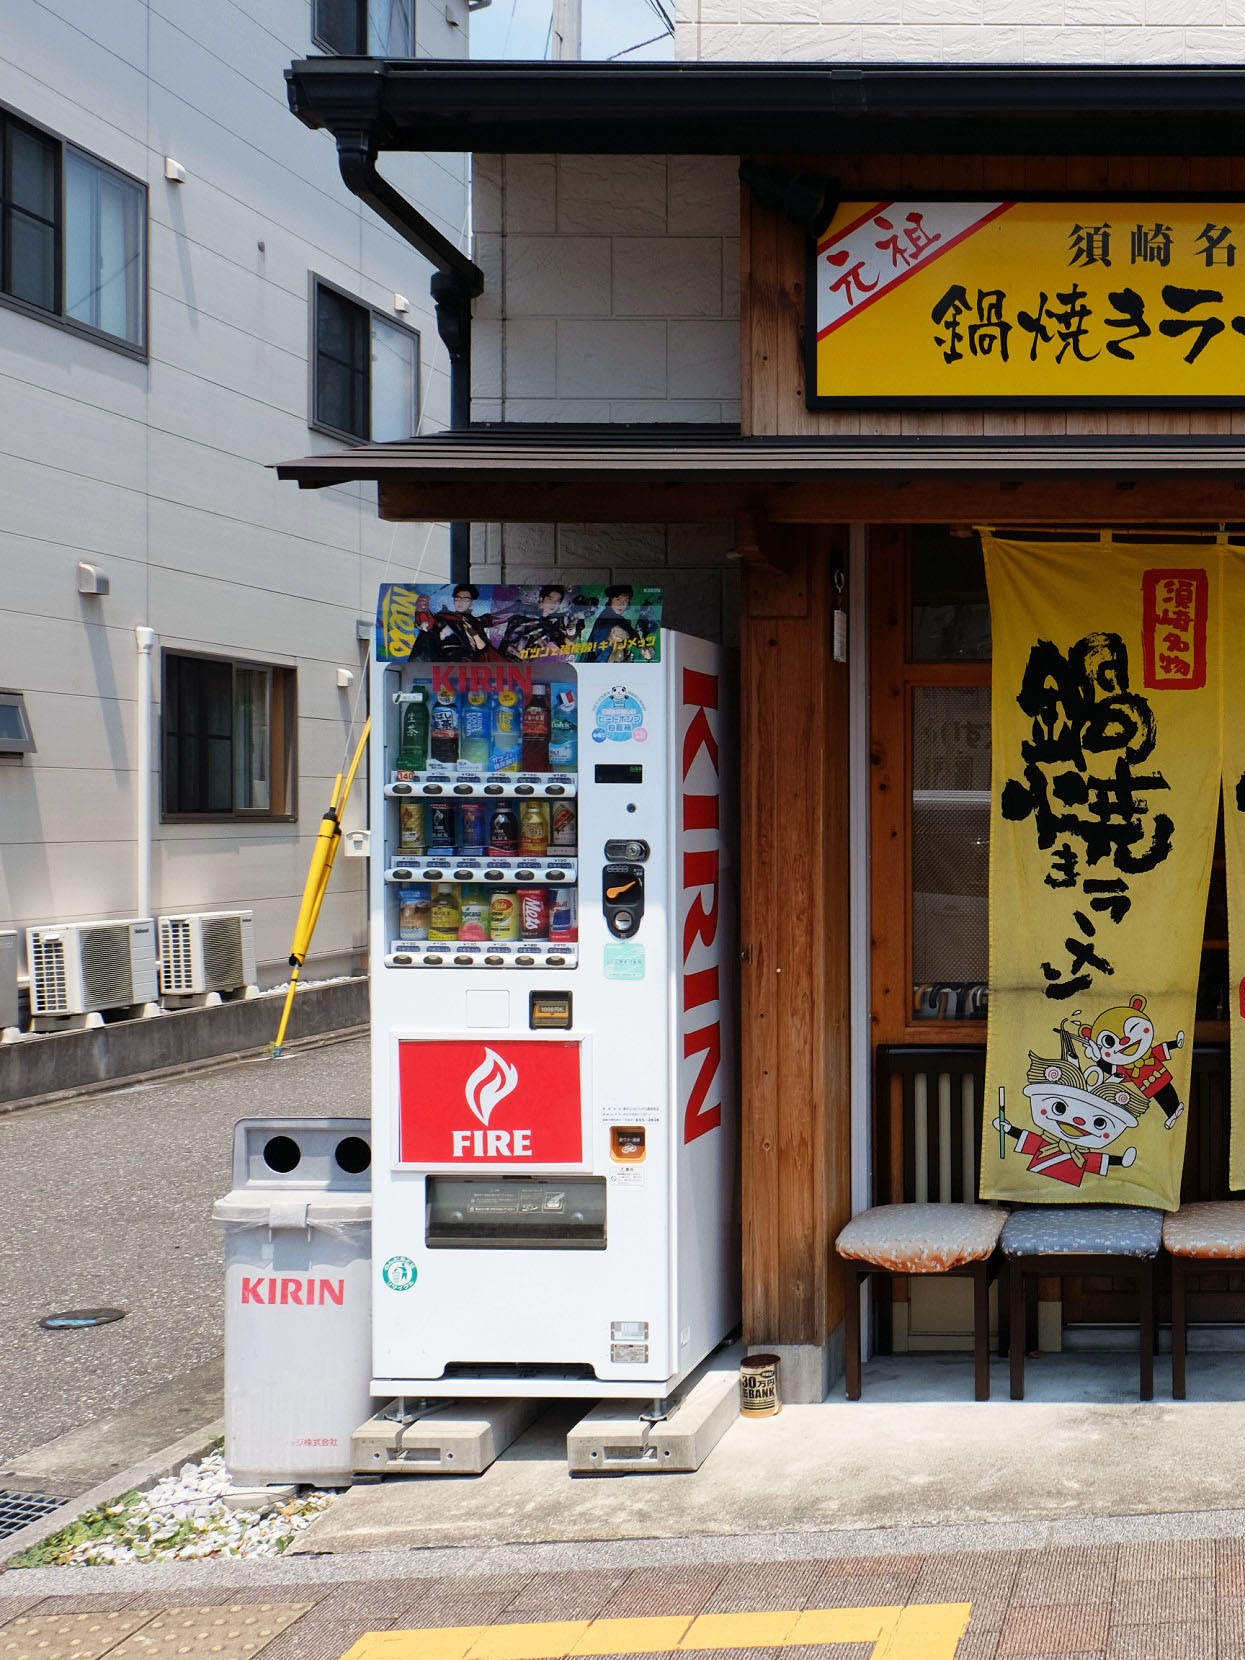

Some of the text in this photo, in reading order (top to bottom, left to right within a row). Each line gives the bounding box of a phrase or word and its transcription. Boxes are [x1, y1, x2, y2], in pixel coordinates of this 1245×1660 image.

[825, 211, 942, 306] 元祖
[1156, 579, 1194, 678] 須崎名物
[432, 665, 532, 693] KIRIN
[407, 712, 419, 736] 生茶
[1001, 632, 1174, 999] 鍋焼きラーメン
[525, 897, 541, 930] Mets
[683, 667, 721, 1145] KIRIN
[452, 1129, 533, 1157] FIRE
[241, 1277, 344, 1306] KIRIN
[749, 1387, 775, 1399] BANK
